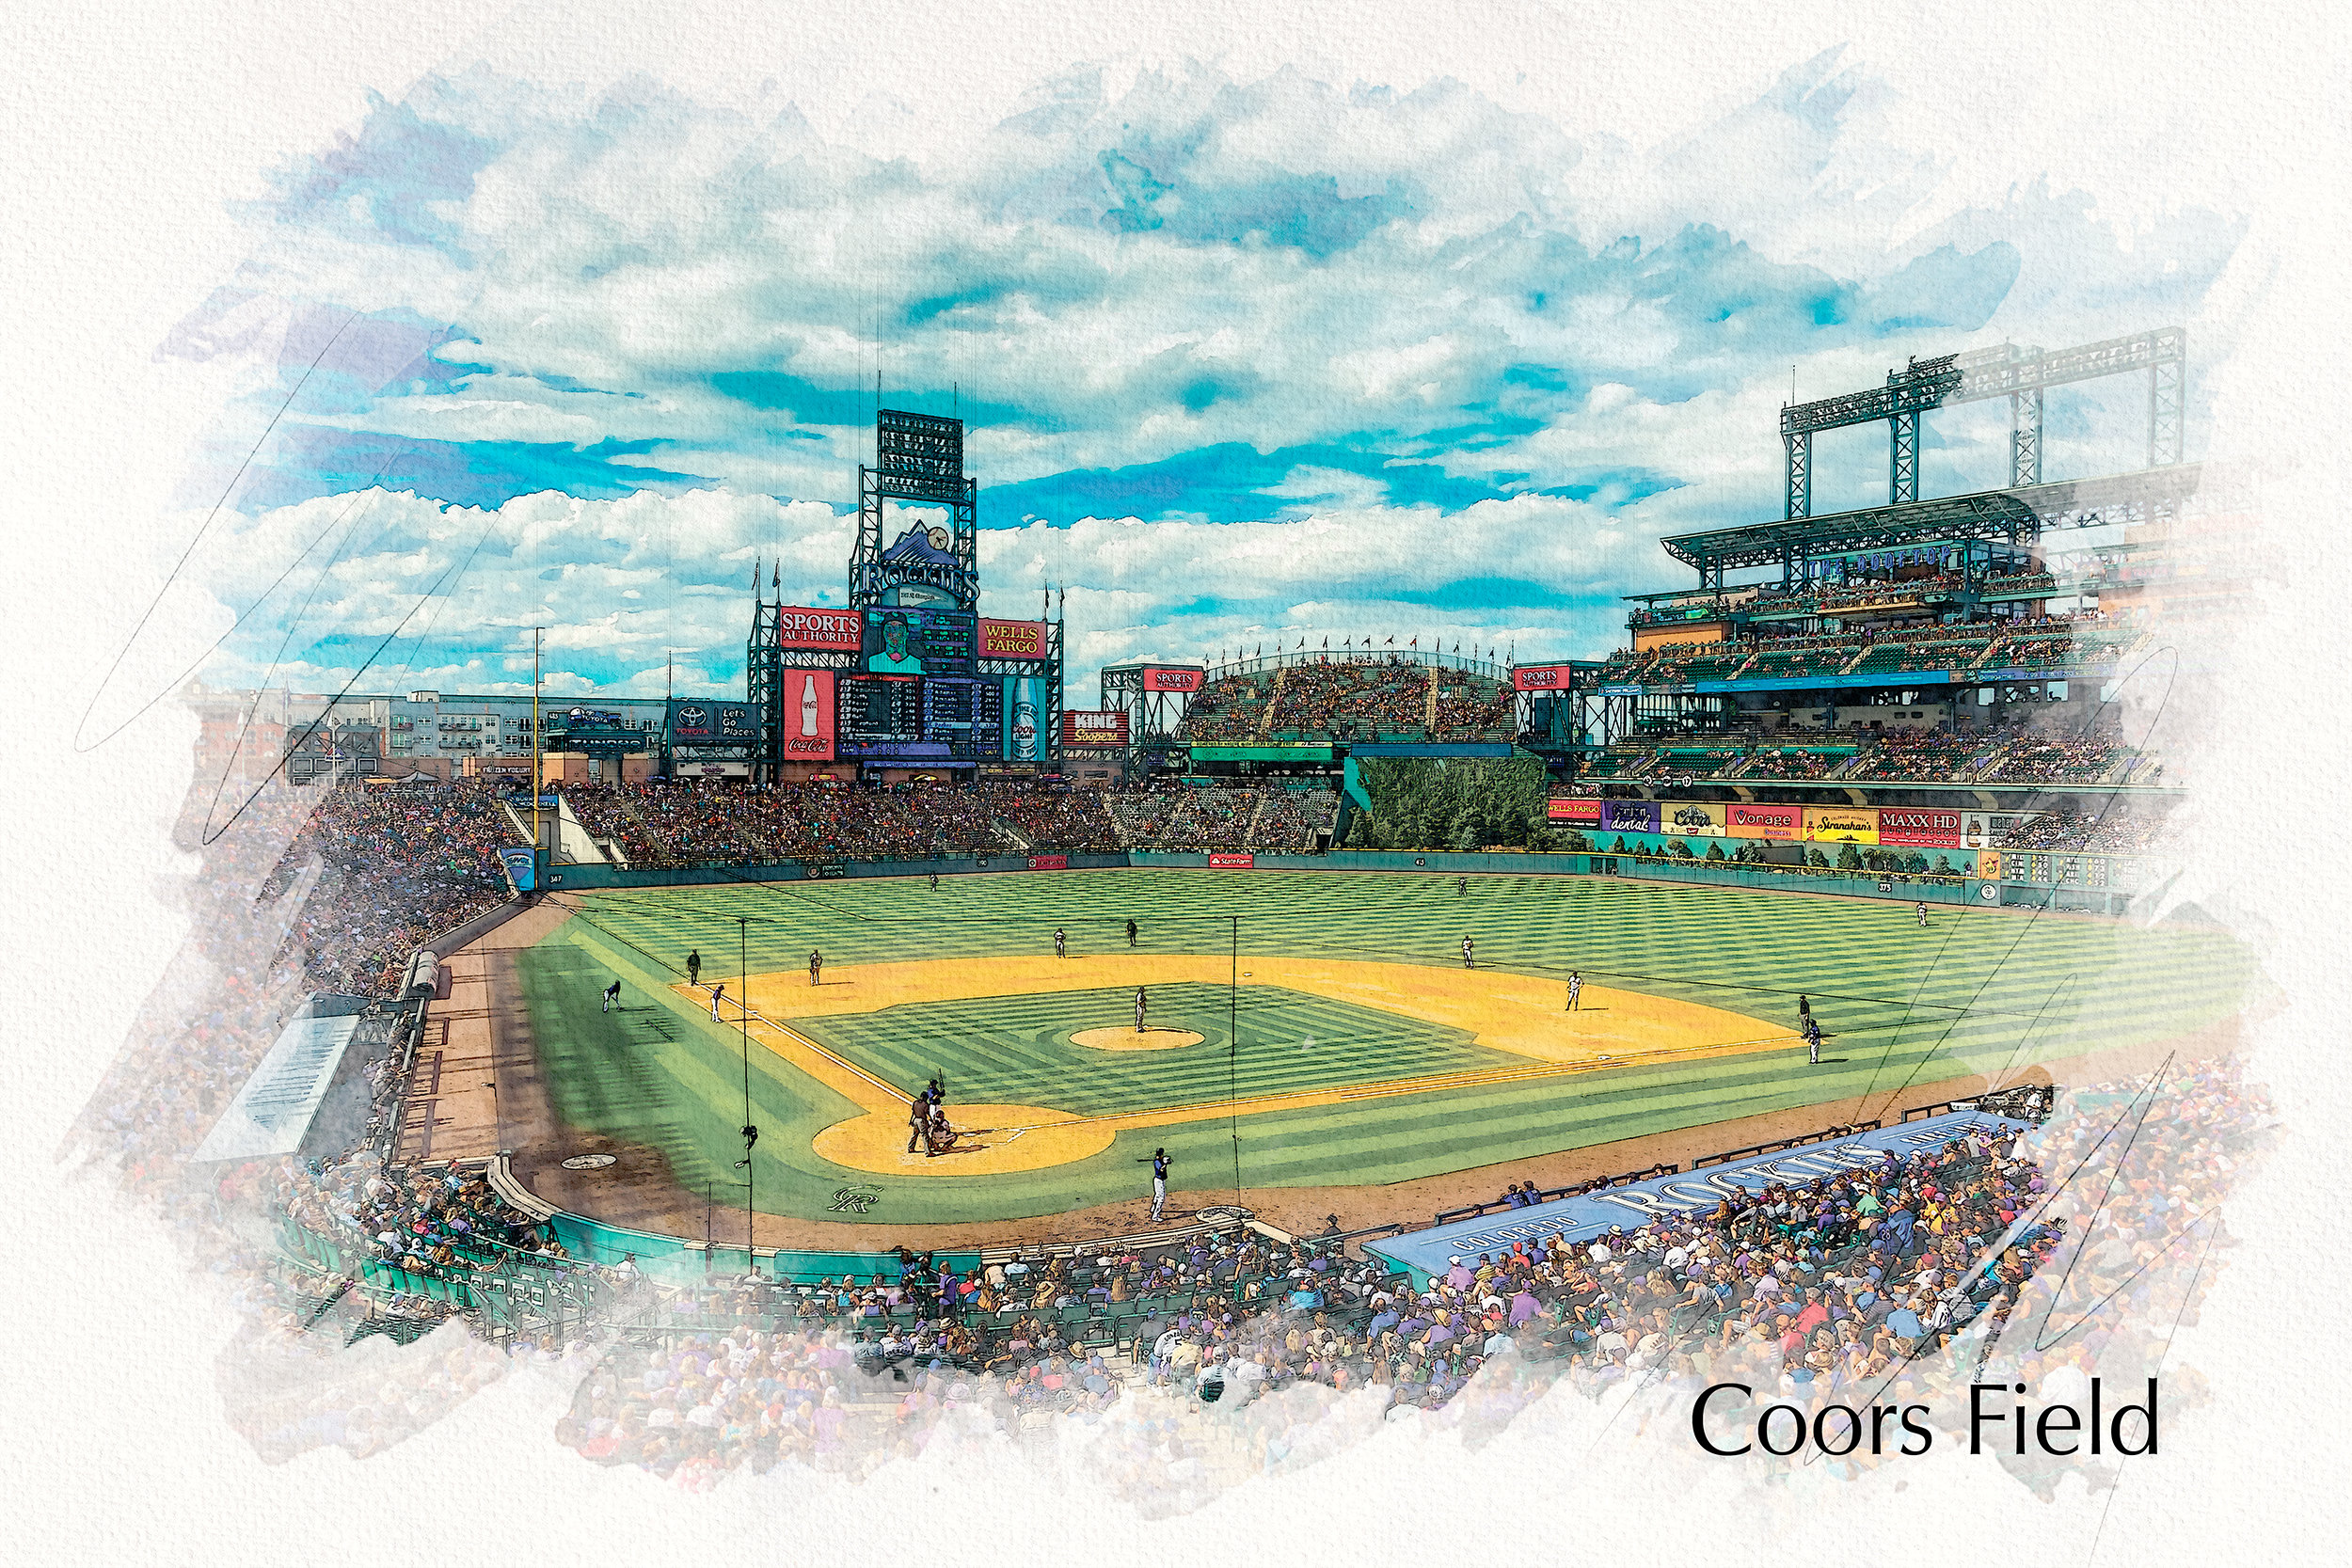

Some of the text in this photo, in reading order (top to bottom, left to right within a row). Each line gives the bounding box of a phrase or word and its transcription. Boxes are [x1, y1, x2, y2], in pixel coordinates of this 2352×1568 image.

[1809, 545, 1950, 577] THE ROOFTOP
[860, 562, 980, 602] ROCKIES
[782, 613, 860, 633] SPORTS
[783, 630, 859, 643] AUTHORITY
[985, 625, 1039, 640] WELLS
[986, 639, 1038, 654] FARGO
[1156, 673, 1193, 683] SPORTS
[1522, 670, 1557, 682] SPORTS
[723, 707, 745, 719] Let's
[723, 718, 737, 727] Go
[1074, 714, 1118, 729] KING
[675, 727, 708, 736] TOYOTA
[723, 726, 755, 737] Places
[1074, 728, 1118, 744] Soopers
[1574, 804, 1599, 813] FARGO
[1611, 815, 1649, 832] dental
[1674, 809, 1711, 827] Coors
[1734, 809, 1793, 828] Vonage
[1817, 816, 1872, 832] Stranahan's
[1882, 813, 1958, 829] MAXX HD
[1221, 857, 1251, 865] State Farm
[549, 875, 562, 883] 347
[1879, 883, 1892, 892] 375
[1590, 1142, 1906, 1219] ROCKIES
[1451, 1215, 1580, 1252] COLORADO
[1881, 1228, 1891, 1241] 28
